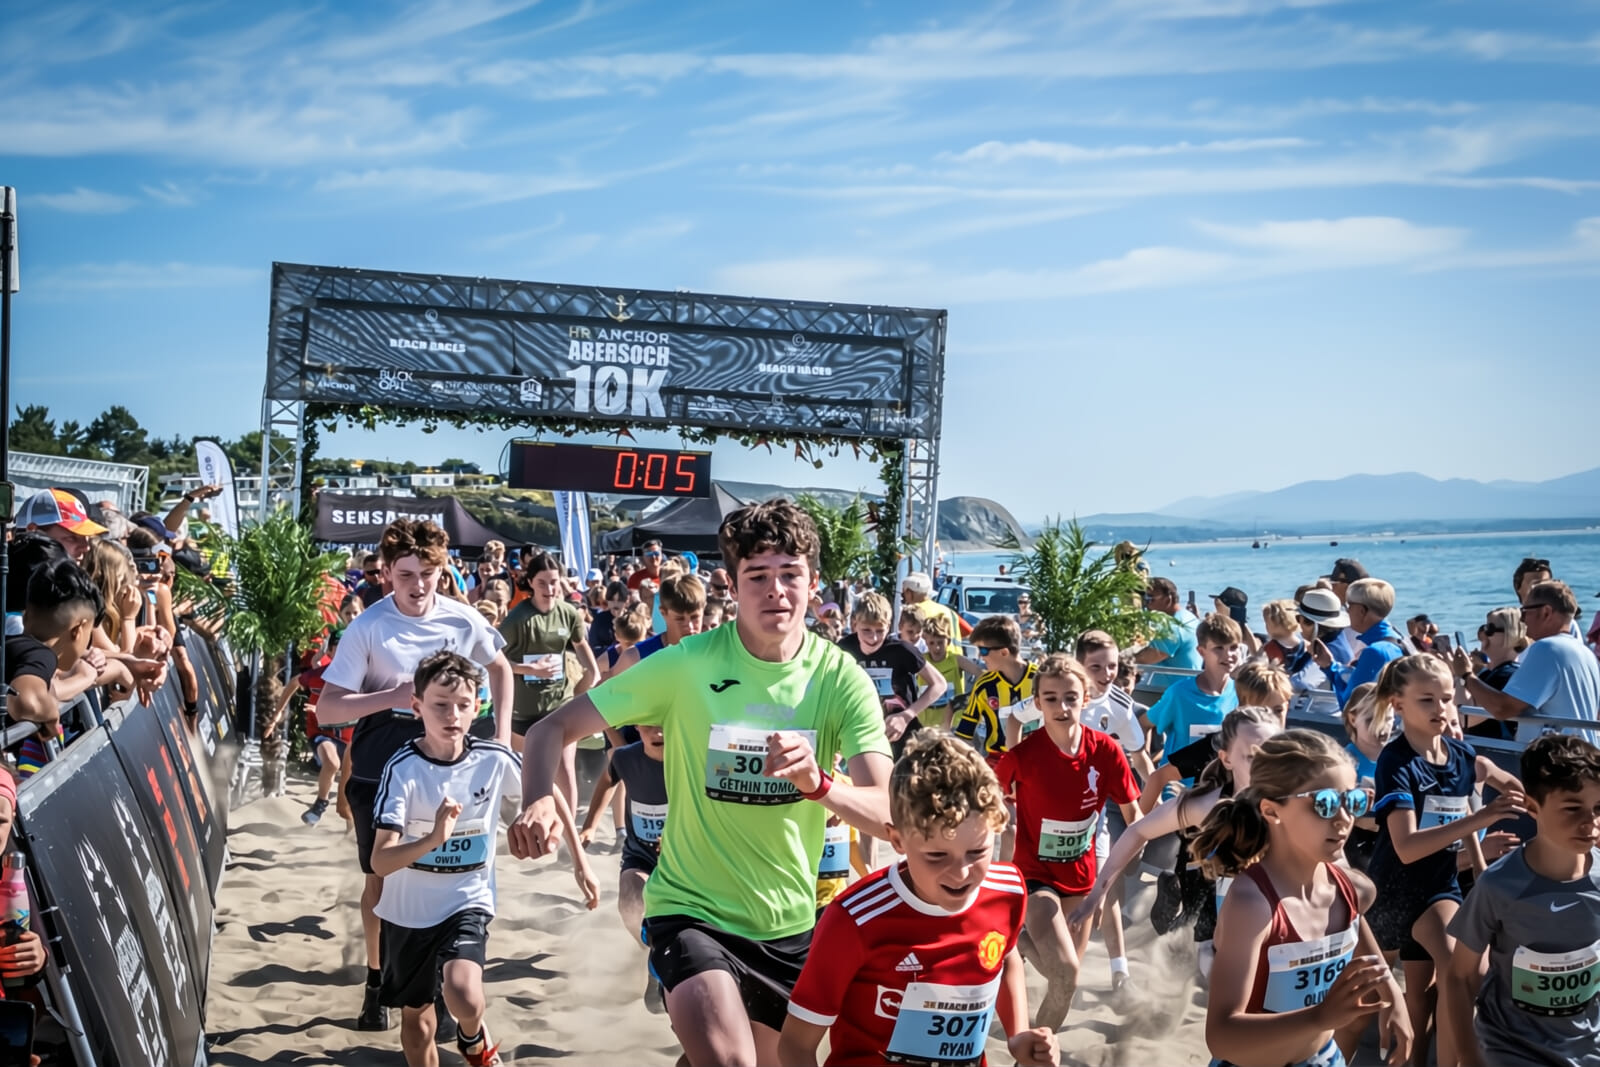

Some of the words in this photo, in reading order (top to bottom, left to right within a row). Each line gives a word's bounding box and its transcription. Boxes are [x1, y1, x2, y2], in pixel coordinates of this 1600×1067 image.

[569, 326, 591, 338] HR
[598, 328, 669, 344] ANCHOR
[568, 339, 670, 367] ABERSOCH
[566, 364, 668, 418] 10K
[614, 452, 696, 492] 0:05
[733, 756, 763, 775] 30
[719, 777, 761, 793] GETHIN
[764, 781, 799, 794] TOMO
[435, 855, 462, 864] OWEN
[1294, 958, 1346, 990] 3169
[1537, 970, 1591, 991] 3000
[1549, 994, 1580, 1006] ISAAC
[927, 1012, 988, 1037] 3071
[938, 1042, 974, 1057] RYAN
